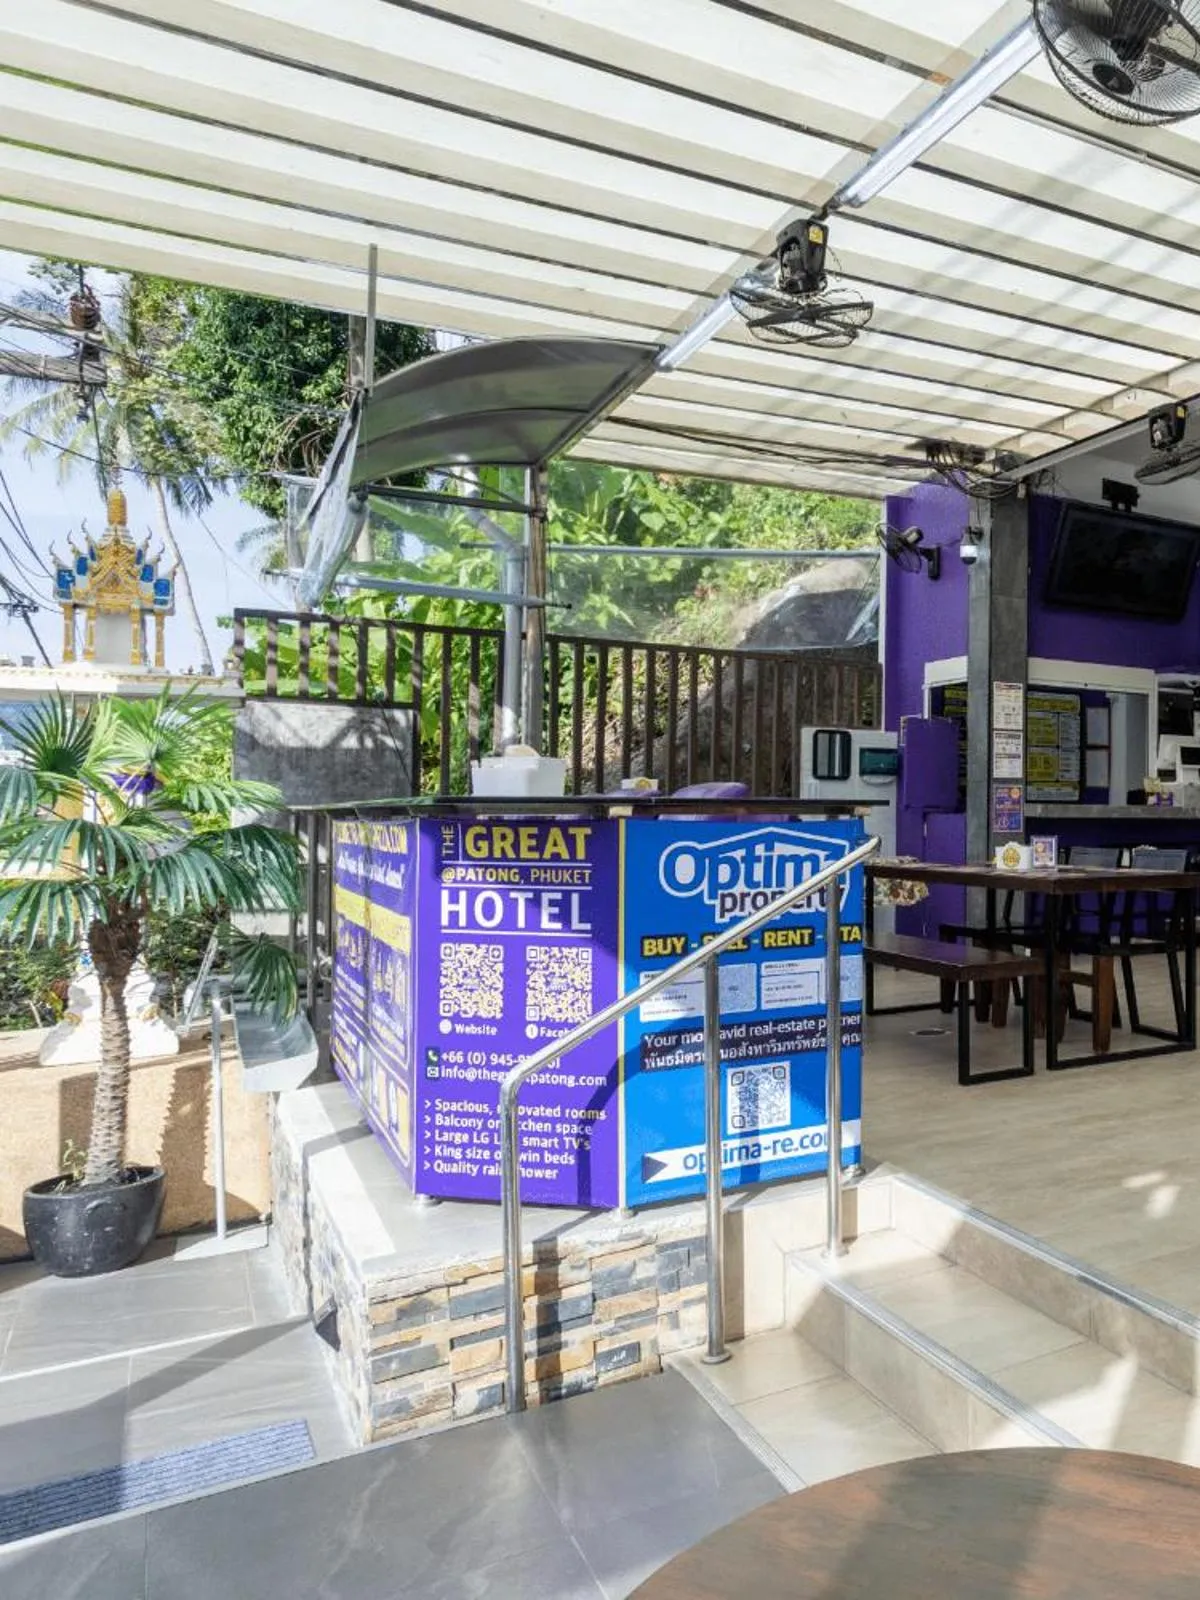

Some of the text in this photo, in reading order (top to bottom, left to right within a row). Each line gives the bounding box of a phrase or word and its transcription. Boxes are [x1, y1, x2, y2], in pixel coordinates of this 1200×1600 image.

[441, 824, 454, 857] THE
[465, 826, 592, 860] GREAT
[441, 867, 592, 884] @PATONG, PHUKET
[441, 889, 592, 931] HOTEL
[643, 936, 686, 956] BUY
[763, 928, 812, 947] RENT
[454, 1023, 498, 1036] Website
[644, 1033, 677, 1049] Your
[681, 1032, 704, 1045] mo
[720, 1023, 746, 1040] avid
[749, 1018, 815, 1036] real-estate
[441, 1053, 464, 1063] +66
[467, 1052, 486, 1066] (0)
[441, 1066, 607, 1088] info@thegpatong.com
[434, 1098, 493, 1116] Spacious,
[565, 1108, 607, 1121] rooms
[434, 1113, 483, 1129] Balcony
[555, 1122, 593, 1136] space
[434, 1130, 469, 1144] Large
[473, 1132, 489, 1144] LG
[522, 1136, 559, 1149] smart
[563, 1137, 591, 1150] TV's
[434, 1146, 463, 1159] King
[465, 1146, 491, 1159] size
[518, 1150, 540, 1163] win
[544, 1152, 575, 1165] beds
[433, 1159, 480, 1177] Quality
